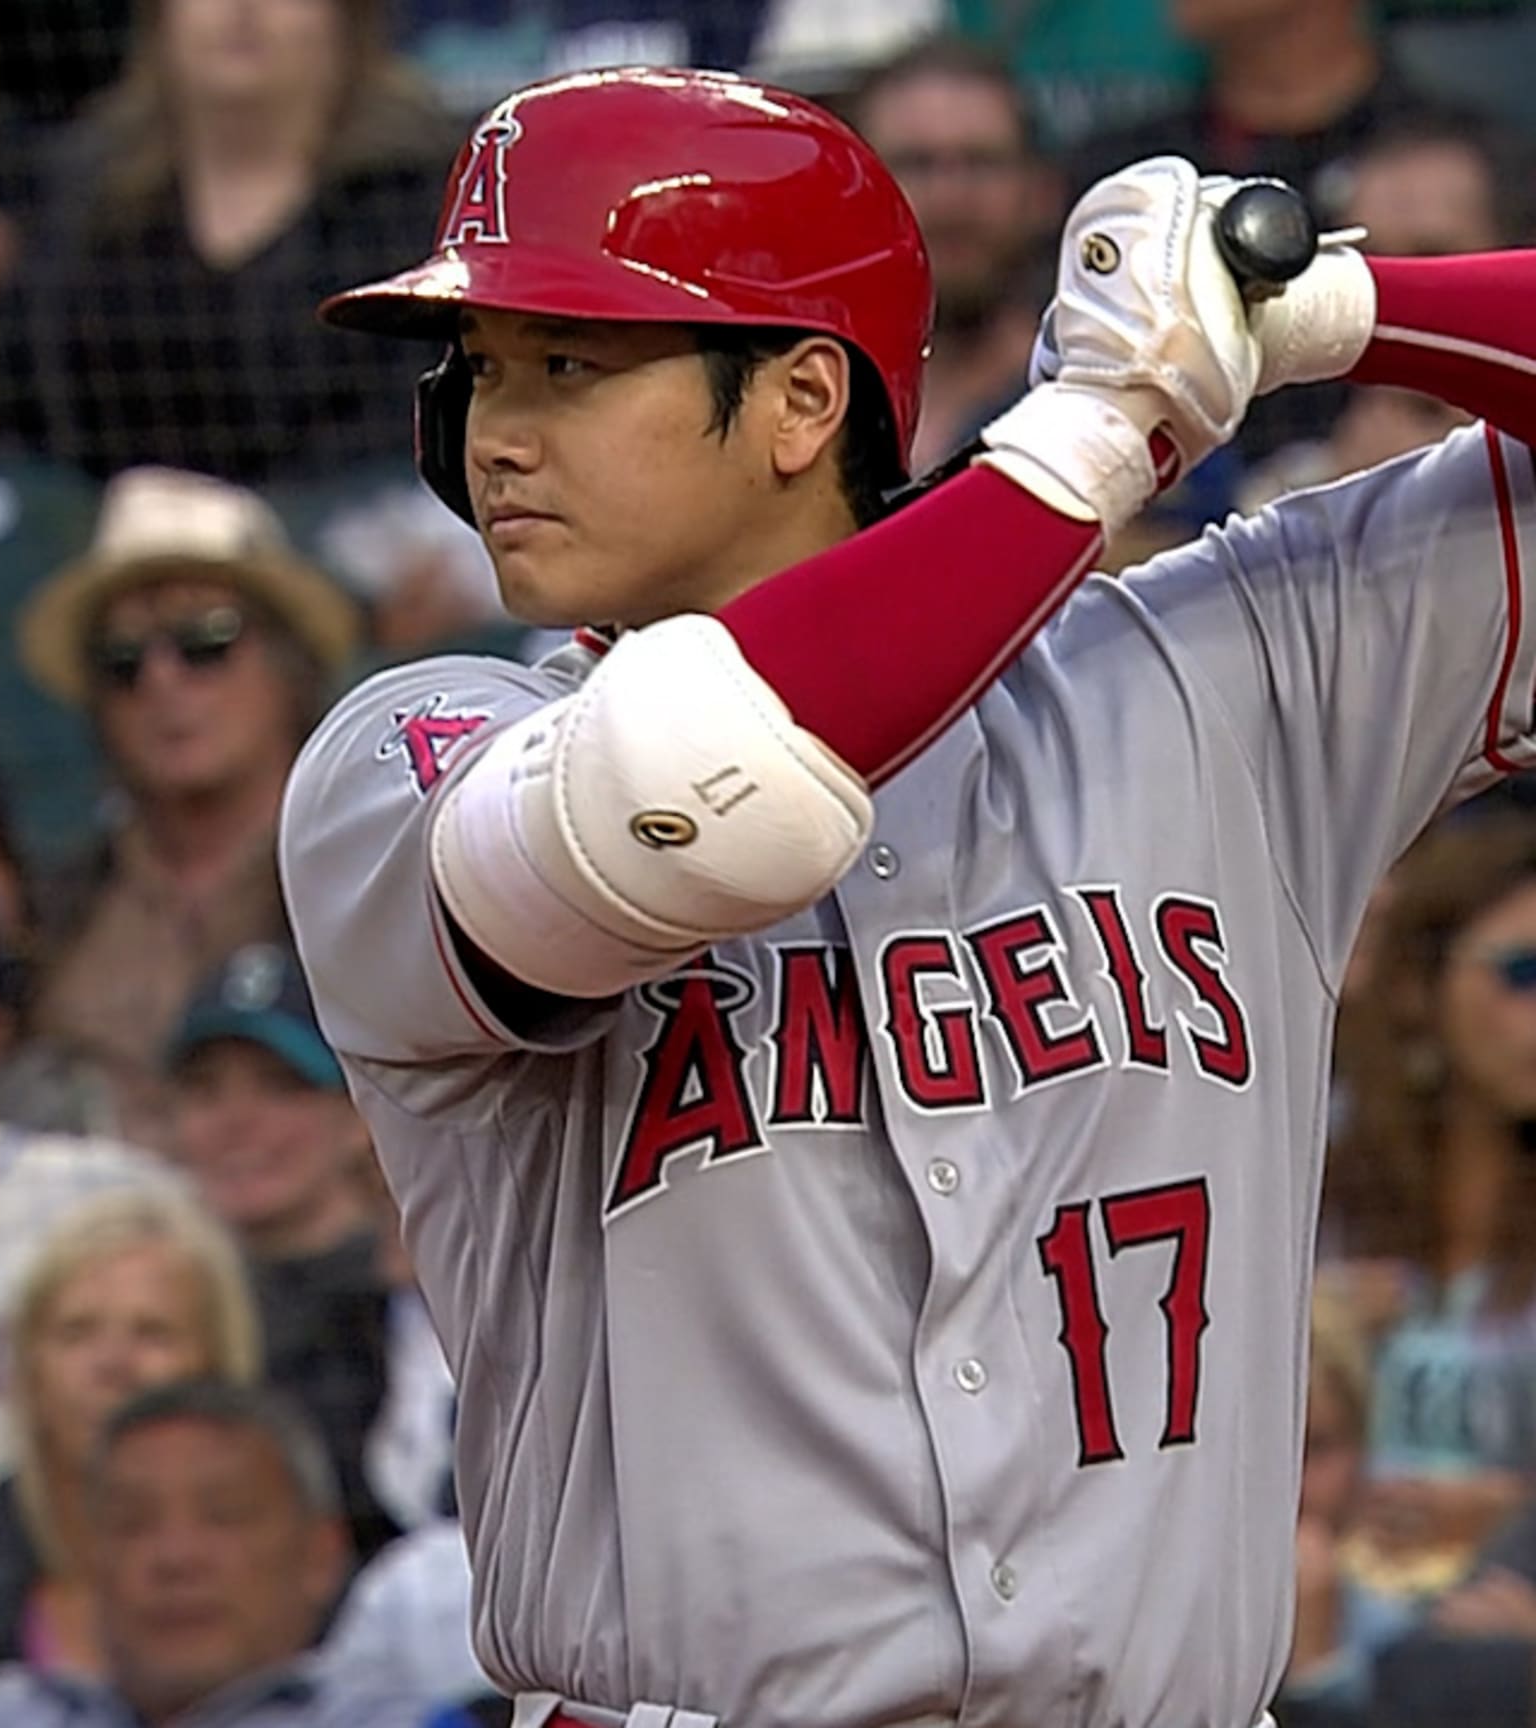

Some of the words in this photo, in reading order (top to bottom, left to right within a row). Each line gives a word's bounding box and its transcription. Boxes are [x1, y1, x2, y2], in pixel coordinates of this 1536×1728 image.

[440, 95, 522, 246] A
[603, 884, 1255, 1225] ANGELS
[1035, 1173, 1212, 1468] 17
